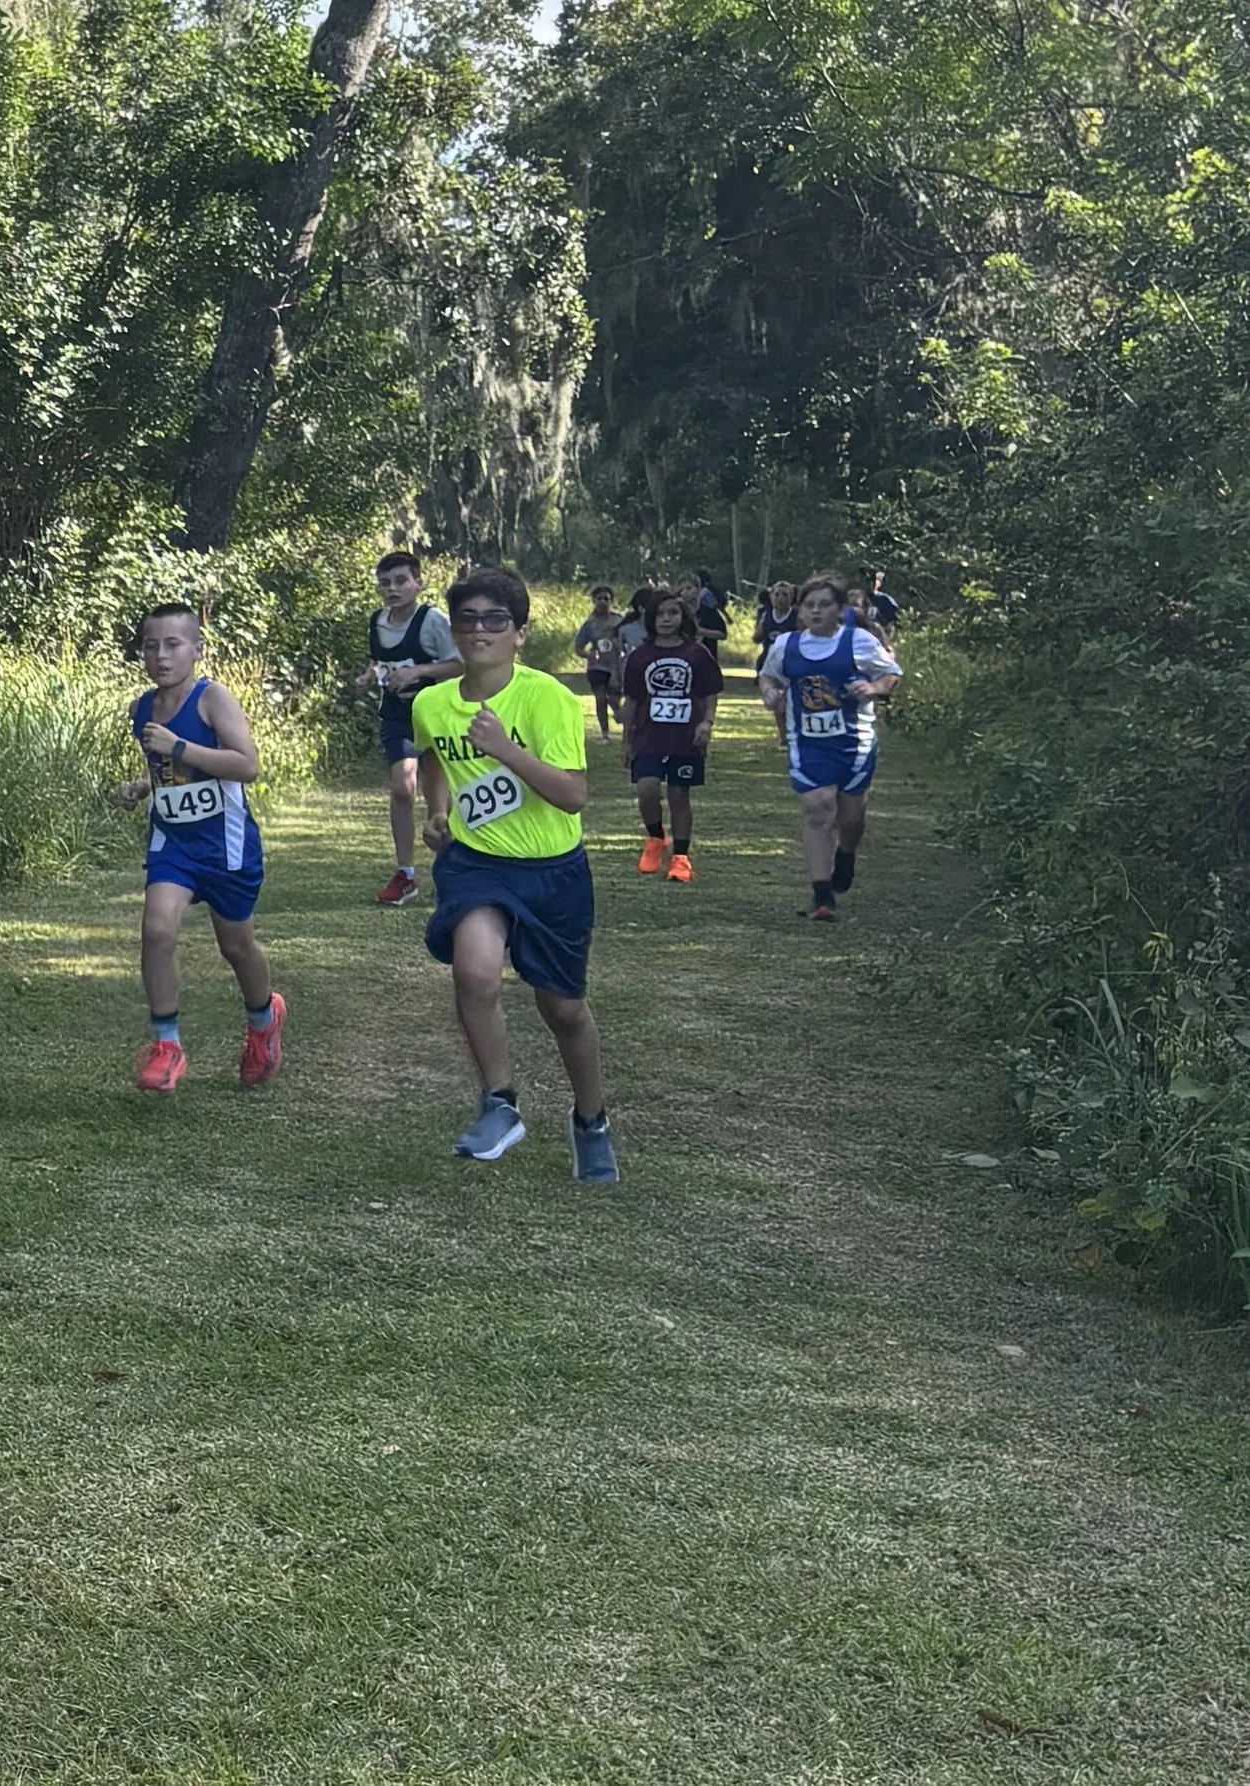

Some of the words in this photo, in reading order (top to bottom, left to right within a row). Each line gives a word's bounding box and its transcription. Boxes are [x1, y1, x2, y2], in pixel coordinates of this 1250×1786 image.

[653, 702, 689, 719] 237
[805, 712, 842, 734] 114
[160, 787, 218, 819] 149
[458, 776, 518, 824] 299
